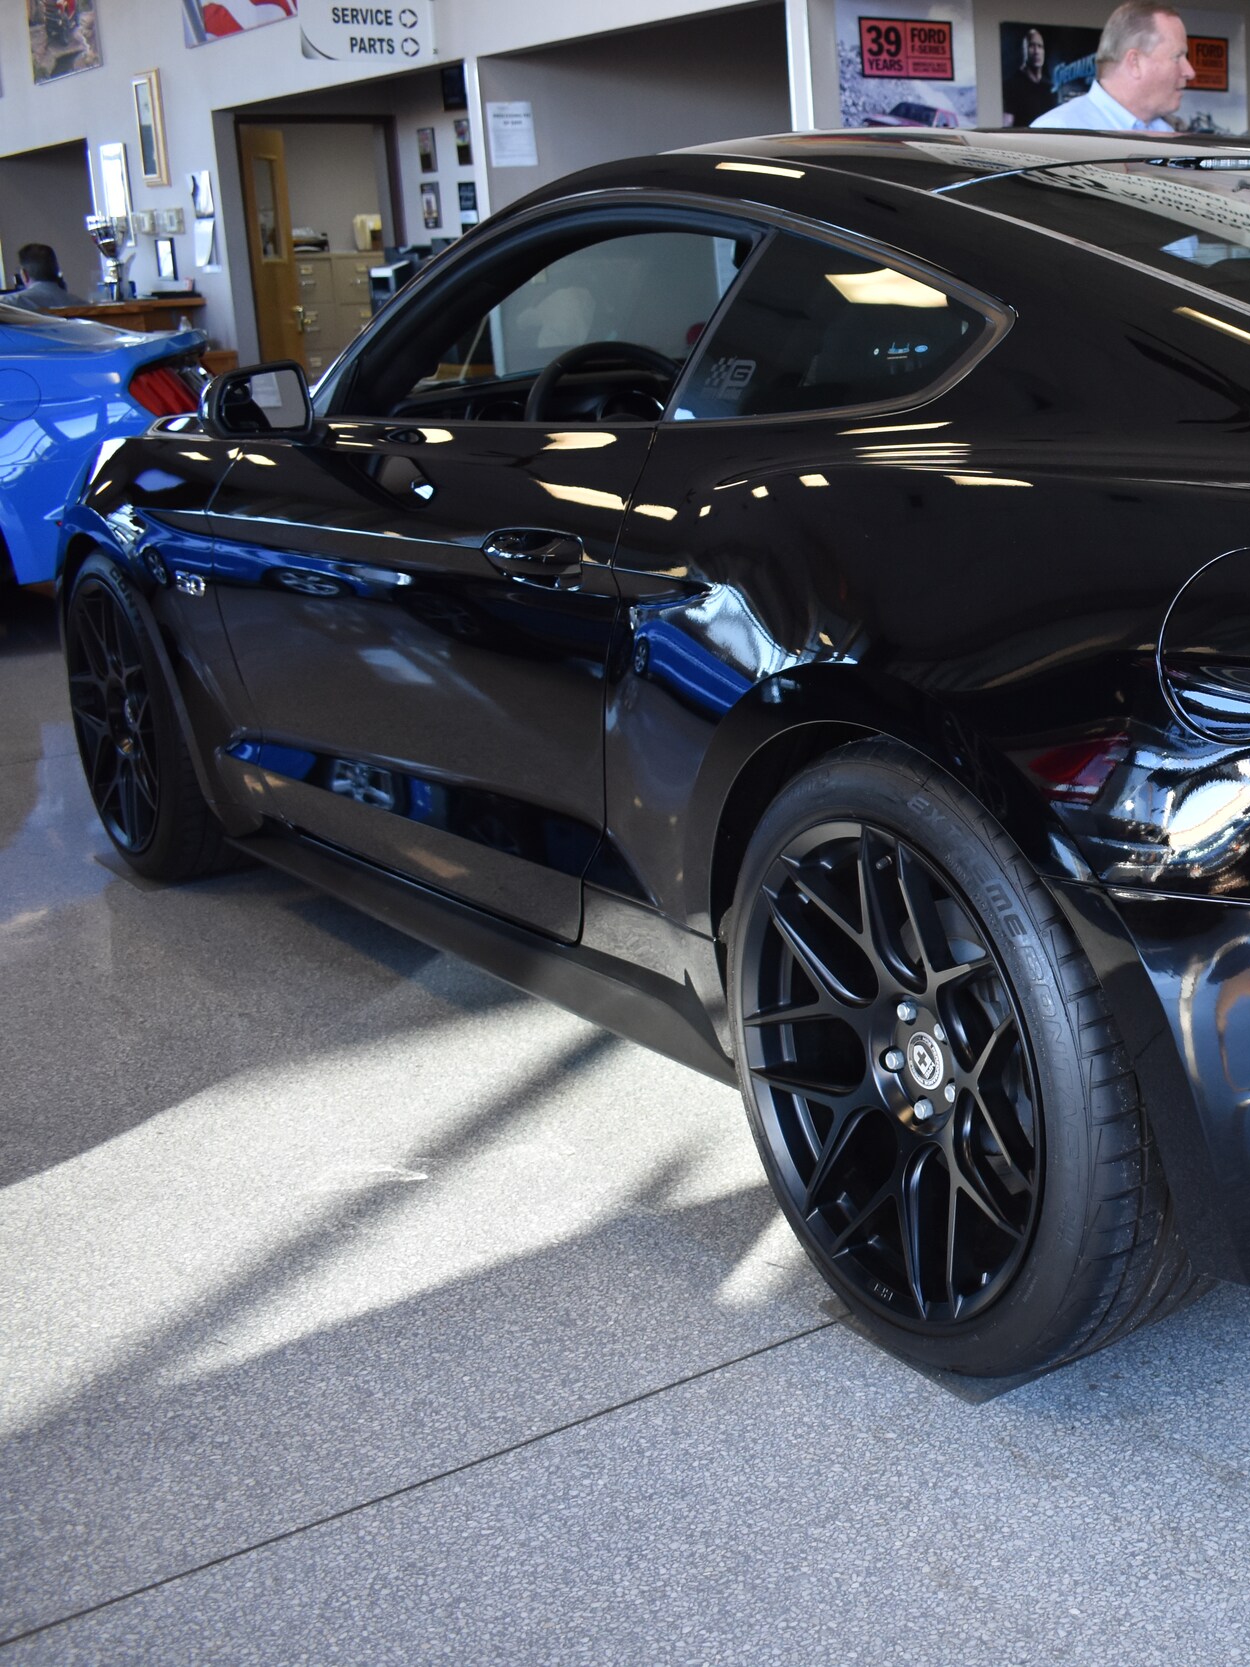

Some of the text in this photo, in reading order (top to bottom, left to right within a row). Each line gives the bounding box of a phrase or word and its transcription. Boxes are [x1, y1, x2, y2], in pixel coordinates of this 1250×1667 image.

[332, 7, 394, 26] SERVICE
[866, 25, 902, 58] 39
[910, 27, 947, 45] FORD
[350, 37, 395, 55] PARTS
[911, 44, 947, 55] F-SERIES
[1196, 43, 1224, 58] FORD
[867, 58, 904, 72] YEARS
